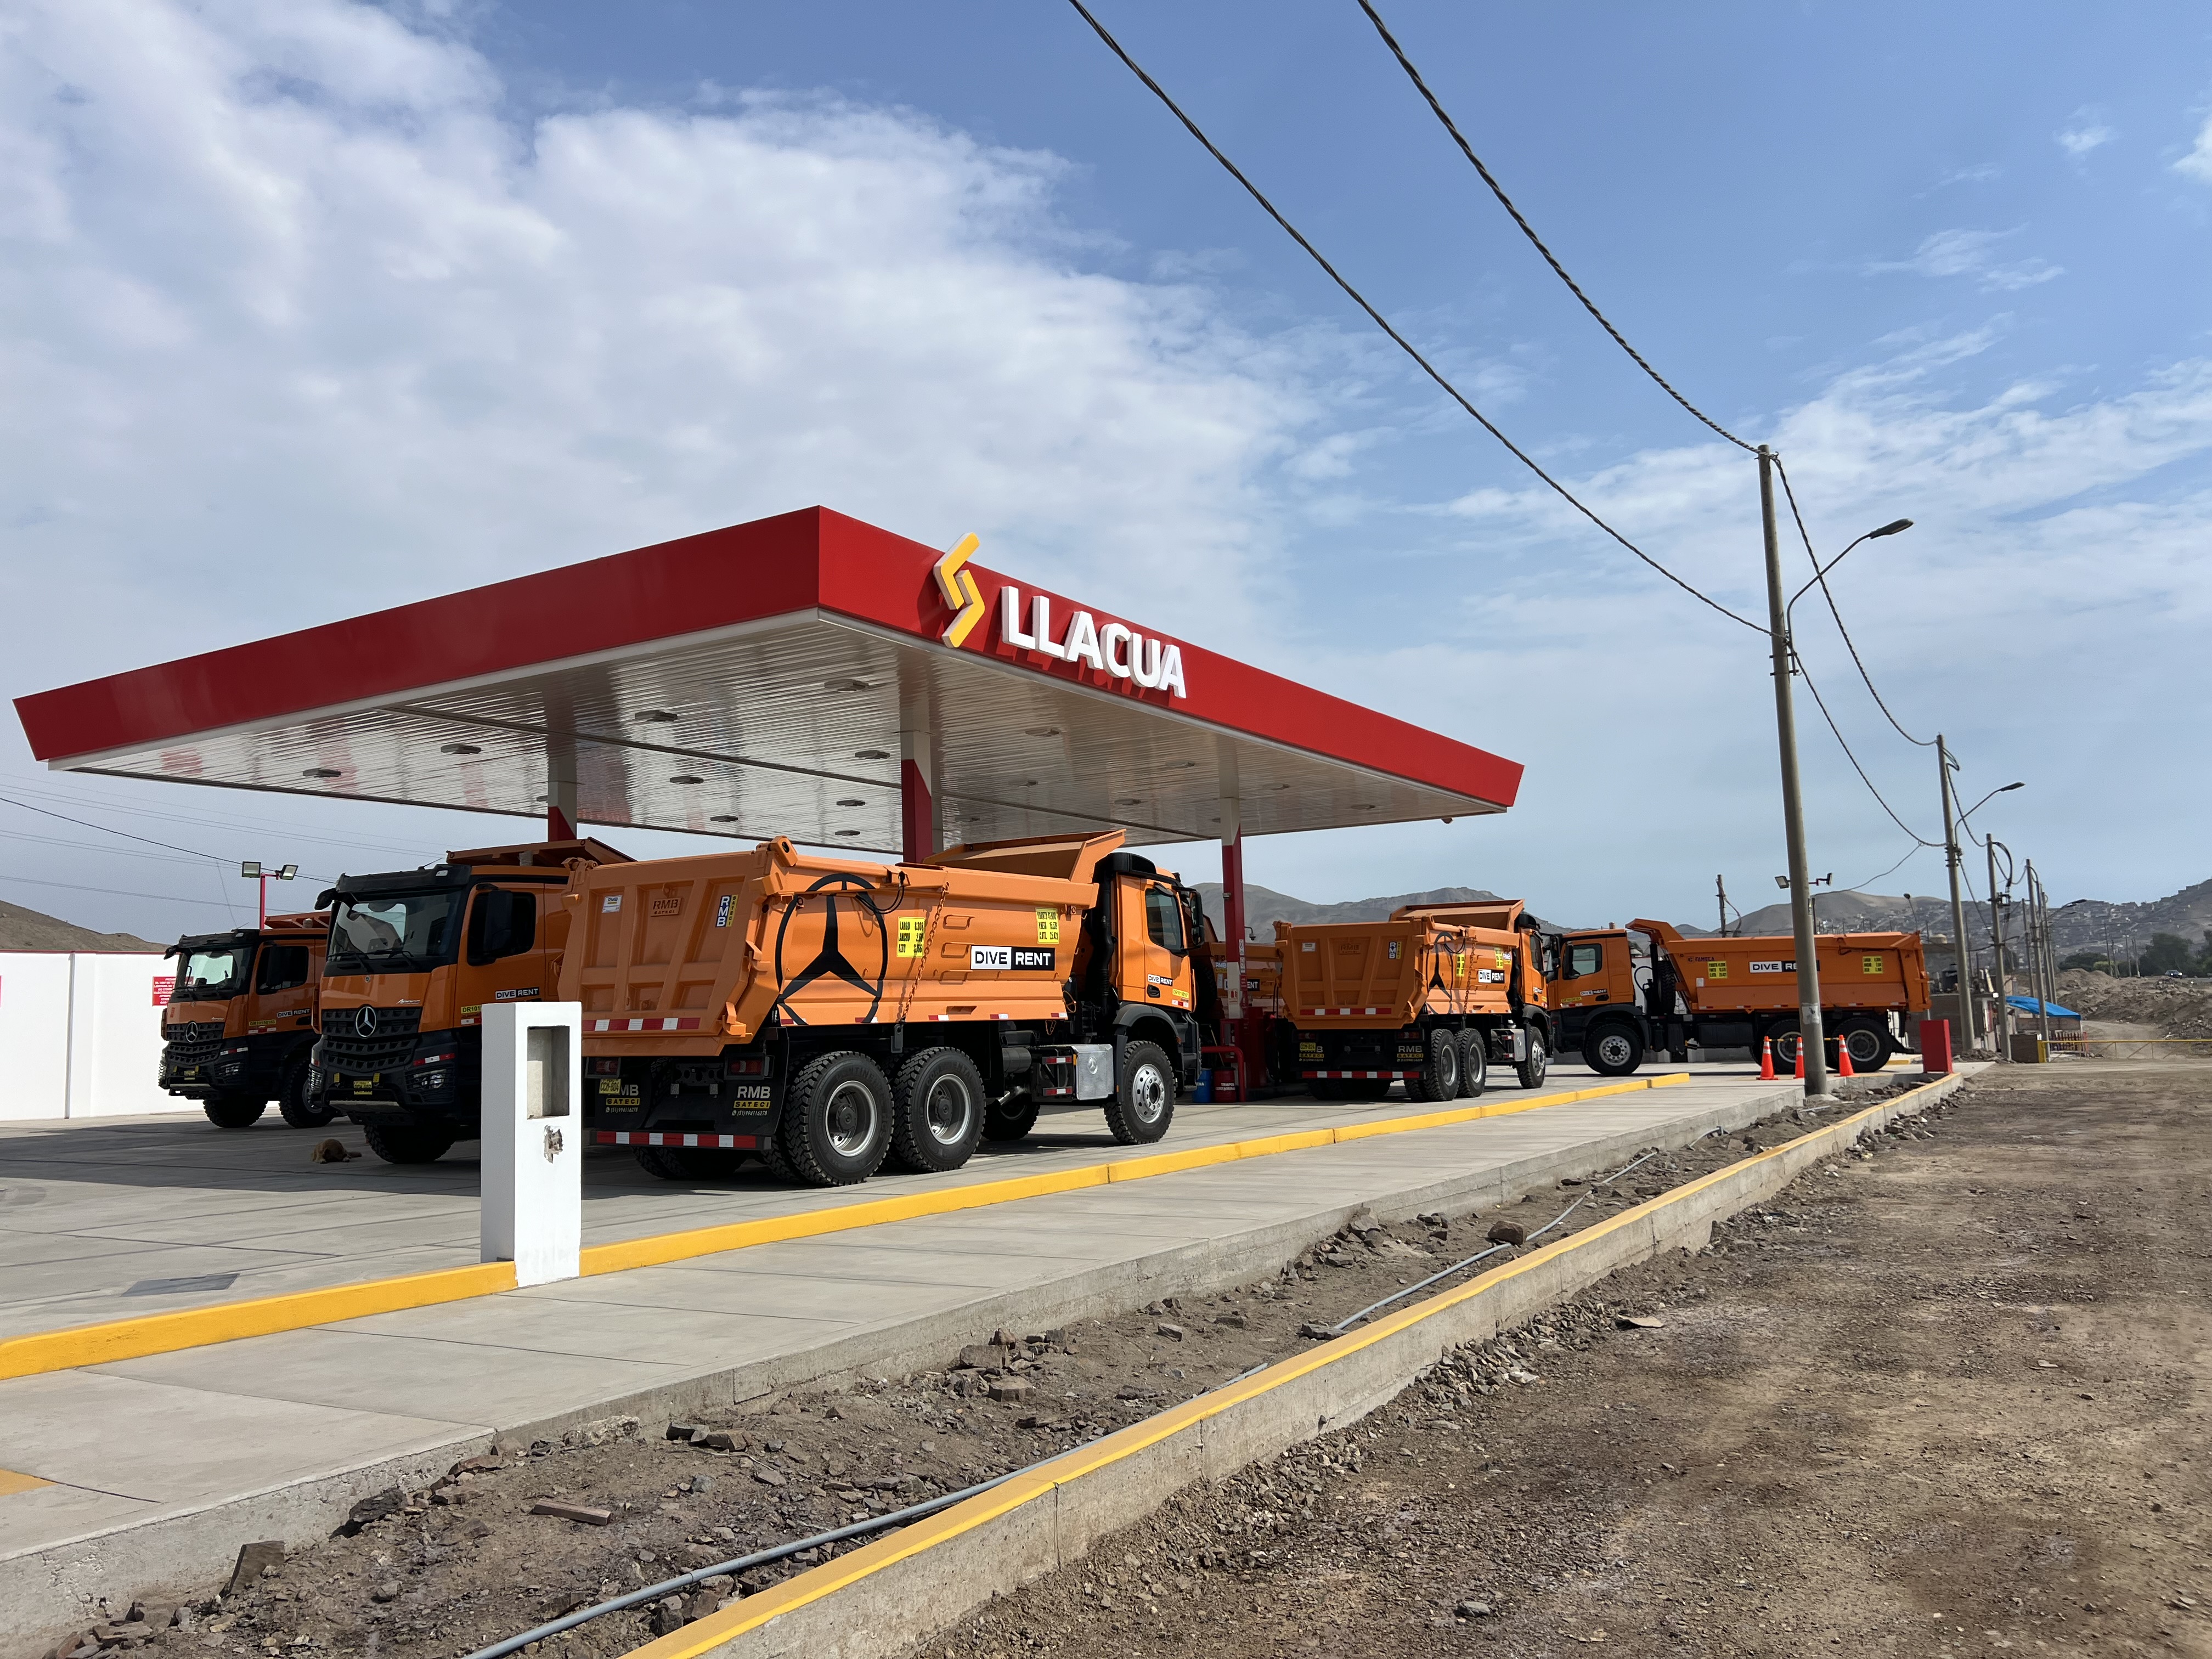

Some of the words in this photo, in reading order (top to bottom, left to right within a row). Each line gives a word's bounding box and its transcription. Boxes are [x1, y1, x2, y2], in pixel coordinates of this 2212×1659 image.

[1001, 585, 1187, 699] LLACUA
[653, 899, 679, 910] RMB
[716, 896, 730, 927] RMB
[975, 951, 1008, 964] DIVE
[1015, 952, 1051, 966] RENT
[1160, 977, 1173, 985] RENT
[1479, 972, 1490, 980] DIVE
[1492, 973, 1504, 981] RENT
[496, 990, 515, 998] DIVE
[517, 988, 539, 996] RENT
[737, 1086, 771, 1099] RMB
